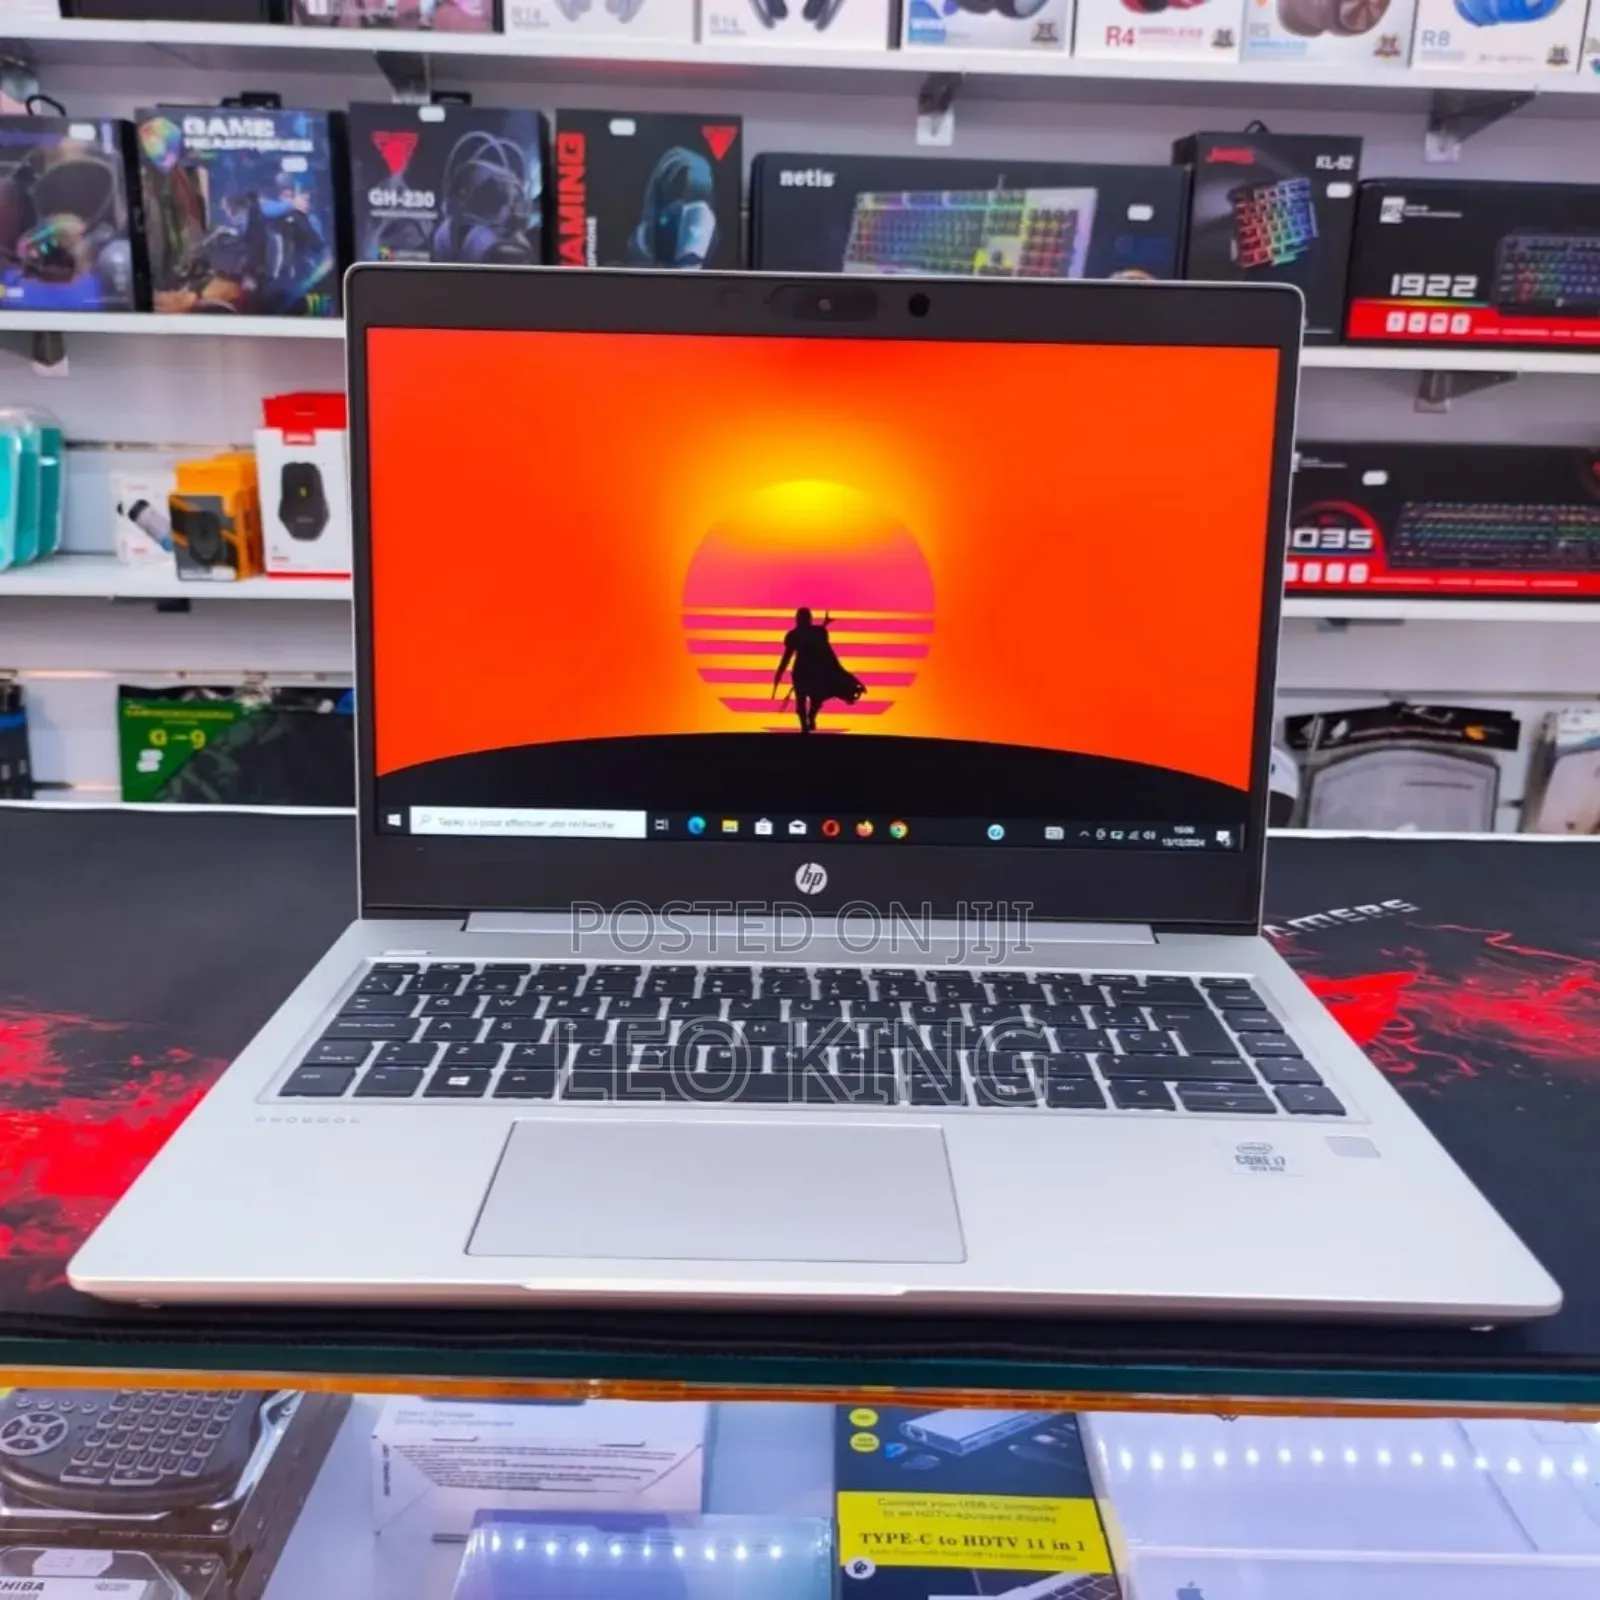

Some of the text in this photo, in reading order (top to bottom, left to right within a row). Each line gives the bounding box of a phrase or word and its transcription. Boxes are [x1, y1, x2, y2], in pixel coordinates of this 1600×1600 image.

[1105, 26, 1136, 47] R4
[1421, 30, 1450, 47] R8
[183, 116, 275, 137] GAME
[780, 168, 836, 188] netis
[557, 131, 586, 267] AMING
[1391, 273, 1478, 298] 1922
[1285, 527, 1374, 549] 035
[1235, 1154, 1271, 1166] CORE
[860, 1532, 1086, 1553] TYPE-C to HDTV 11 in 1
